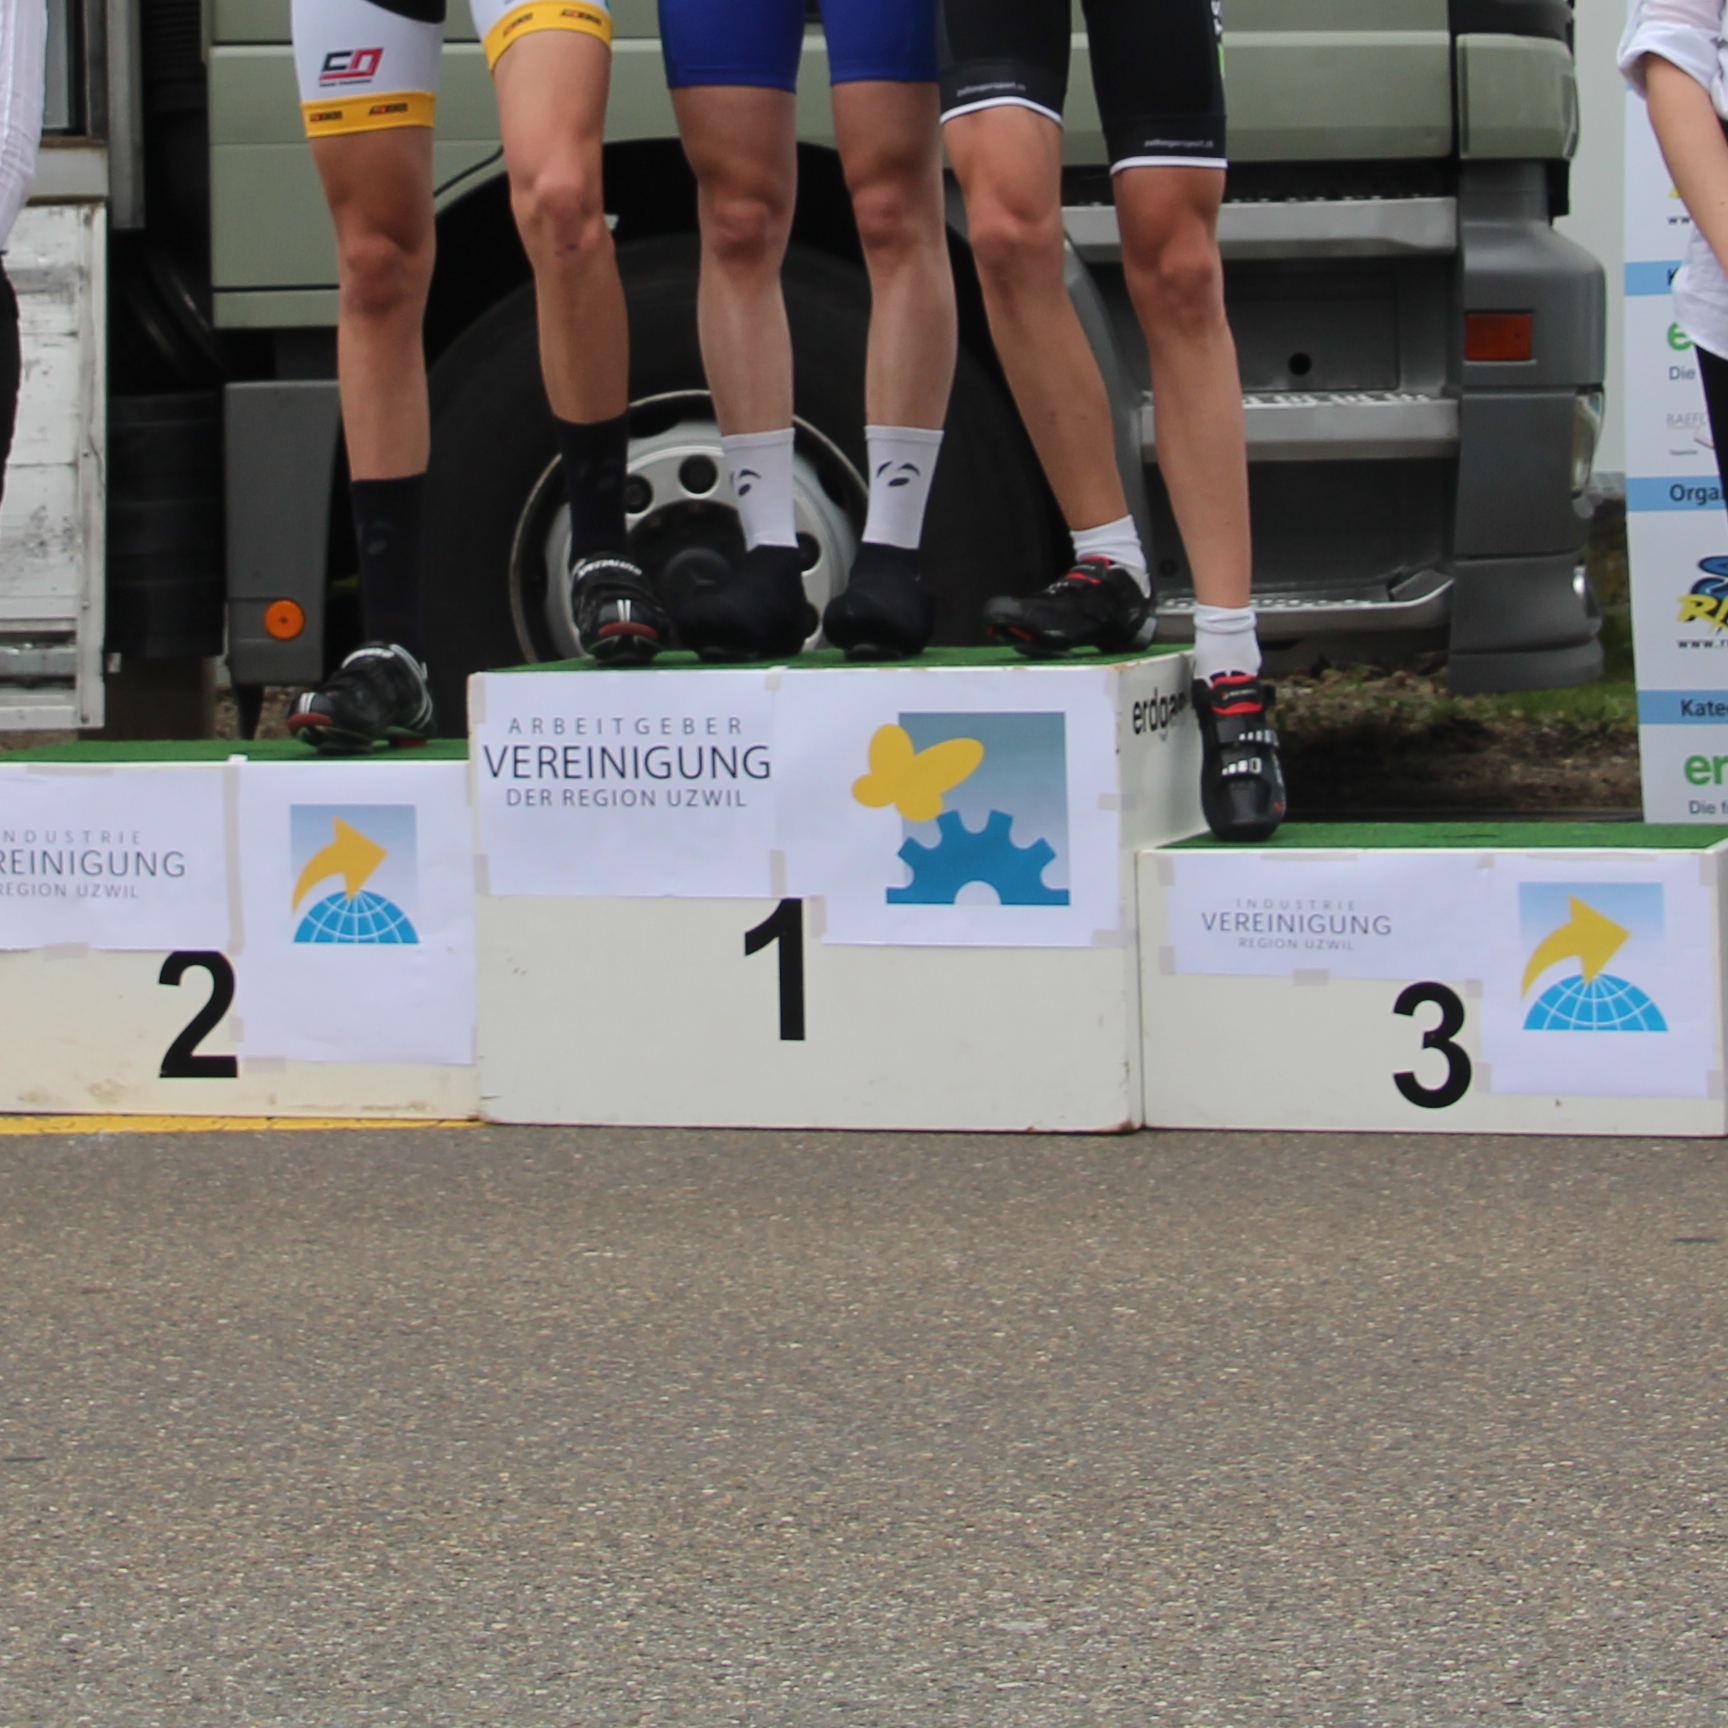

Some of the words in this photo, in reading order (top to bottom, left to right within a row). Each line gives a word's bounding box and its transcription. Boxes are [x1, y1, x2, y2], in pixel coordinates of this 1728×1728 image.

[508, 716, 744, 736] ARBEITGEBER
[483, 744, 772, 780] VEREINIGUNG
[506, 789, 553, 807] DER
[563, 789, 661, 807] REGION
[667, 789, 747, 808] UZWIL
[1688, 801, 1716, 814] Die
[76, 883, 139, 899] UZWIL
[1235, 898, 1357, 912] INDUSTRIE
[1200, 911, 1393, 937] VEREINIGUNG
[1238, 937, 1299, 950] REGION
[1305, 938, 1355, 951] UZWIL
[744, 898, 806, 1041] 1
[158, 951, 238, 1078] 2
[1393, 981, 1472, 1109] 3
